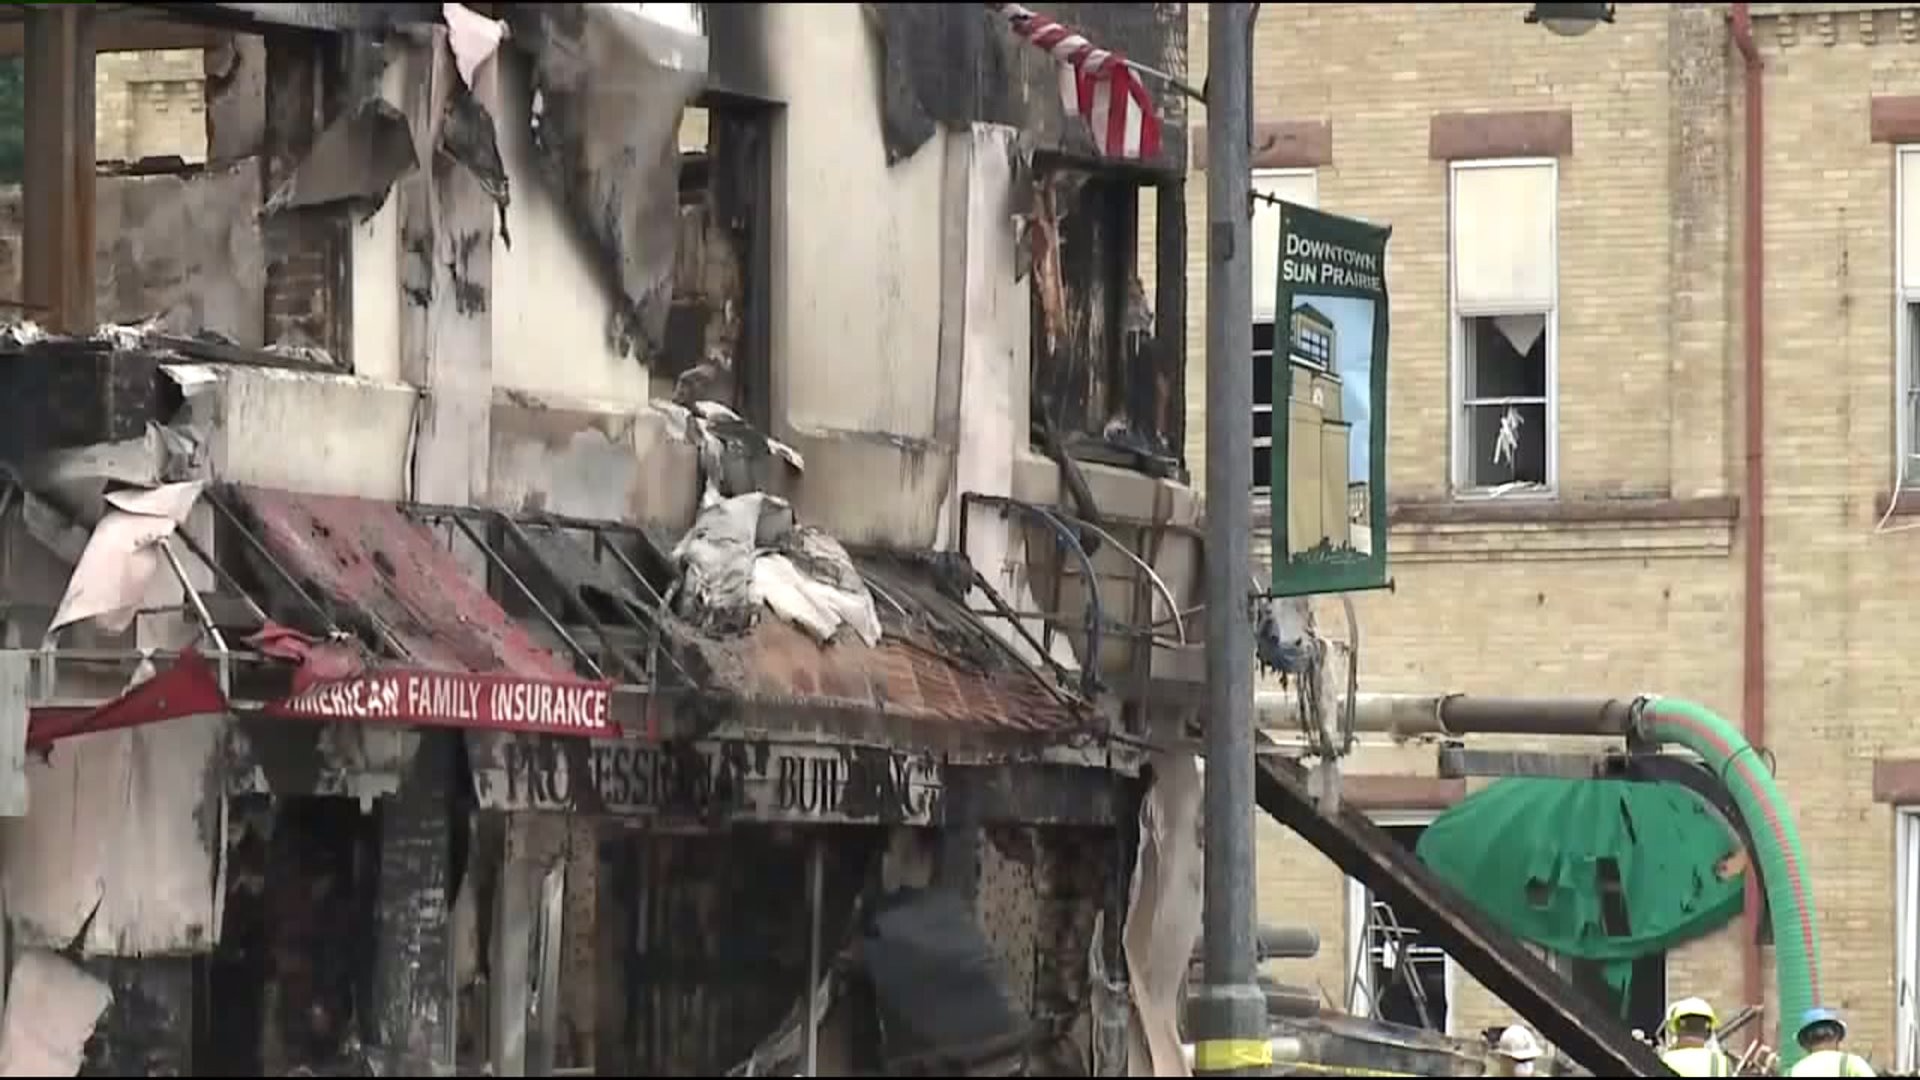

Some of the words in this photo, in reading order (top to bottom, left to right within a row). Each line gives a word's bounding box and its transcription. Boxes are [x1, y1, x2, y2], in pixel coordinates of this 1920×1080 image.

[1283, 258, 1318, 283] SUN
[1320, 263, 1381, 291] PRAIRIE
[1286, 233, 1377, 272] DOWNTOWN
[285, 678, 399, 717] AMERICAN
[408, 677, 481, 720] FAMILY
[491, 683, 606, 727] INSURANCE
[503, 741, 766, 806] PROESSIA
[778, 752, 938, 826] BUILNG
